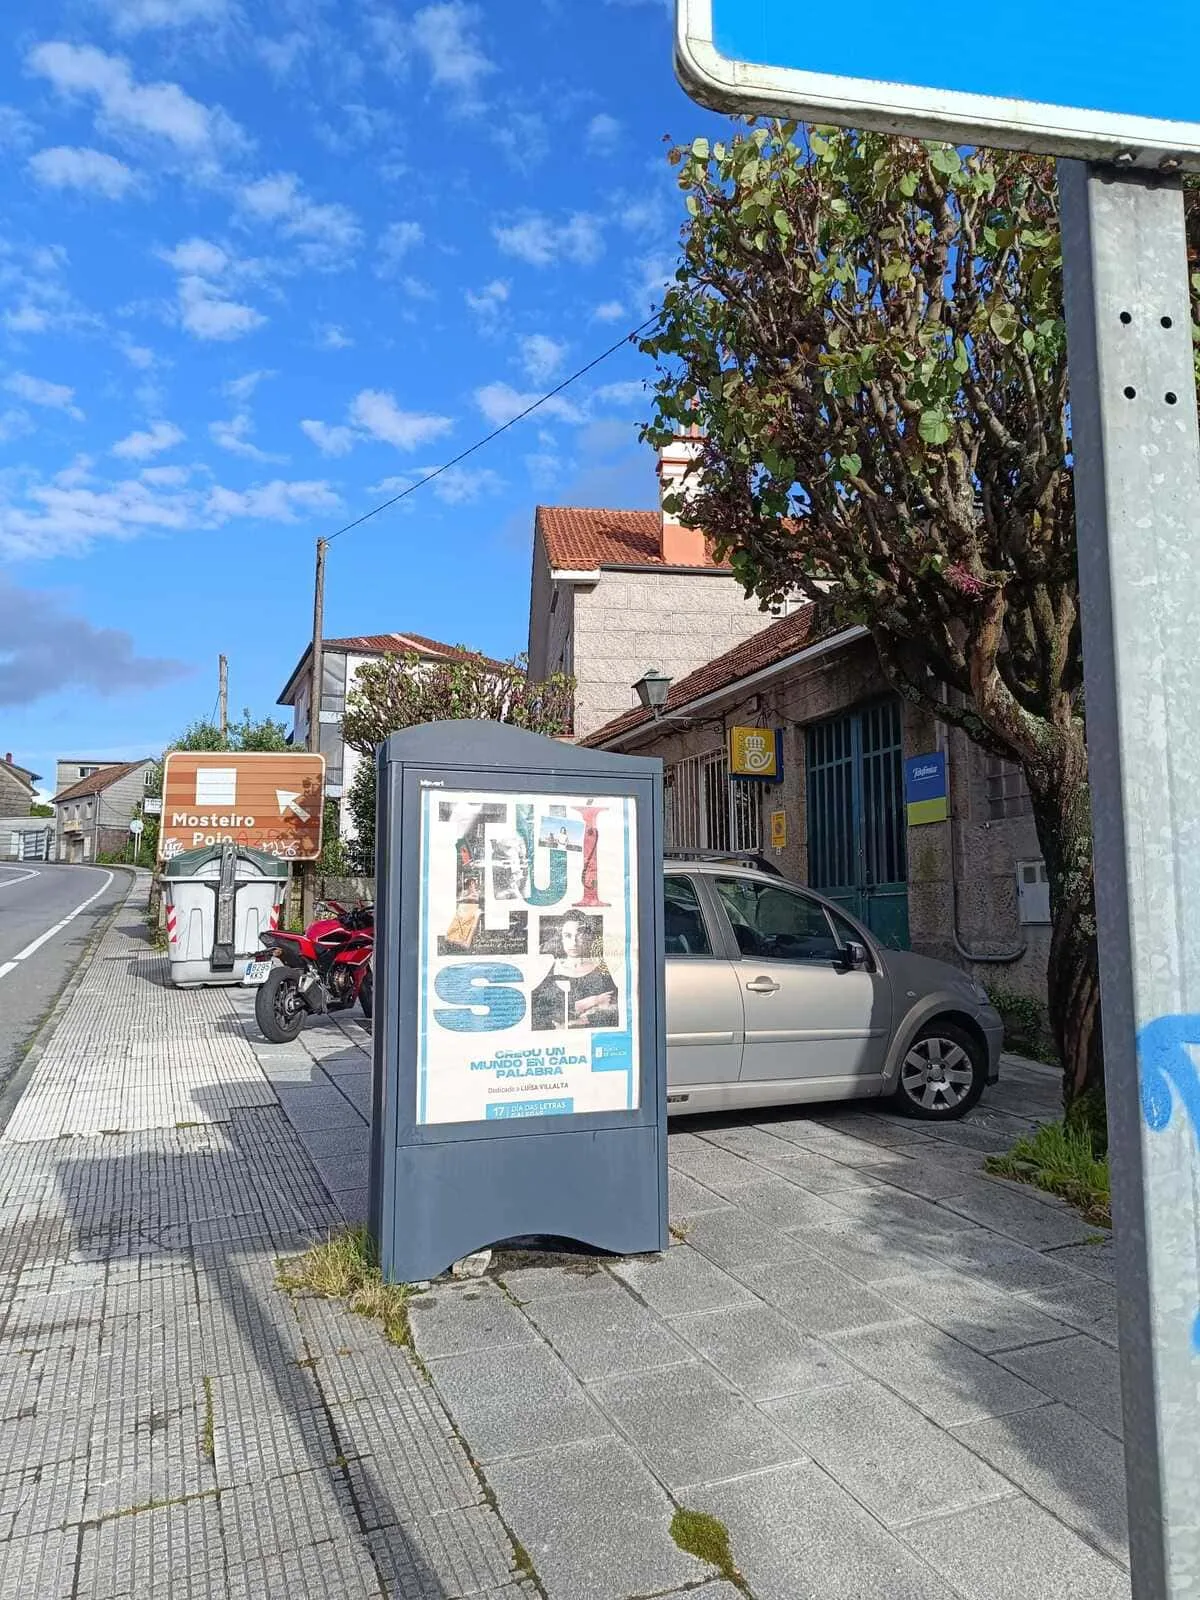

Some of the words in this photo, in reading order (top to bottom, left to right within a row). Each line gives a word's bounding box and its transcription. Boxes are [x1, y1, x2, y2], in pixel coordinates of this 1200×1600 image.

[171, 812, 256, 827] Mosteiro
[192, 831, 233, 846] Poio
[495, 1048, 542, 1059] CREOU
[545, 1046, 566, 1056] UN
[470, 1059, 523, 1071] MUNDO
[526, 1057, 545, 1067] EN
[548, 1055, 588, 1065] CADA
[495, 1066, 564, 1079] PALABRA
[538, 1082, 569, 1090] VILLALTA
[493, 1106, 505, 1117] 17
[539, 1101, 567, 1110] LETRAS
